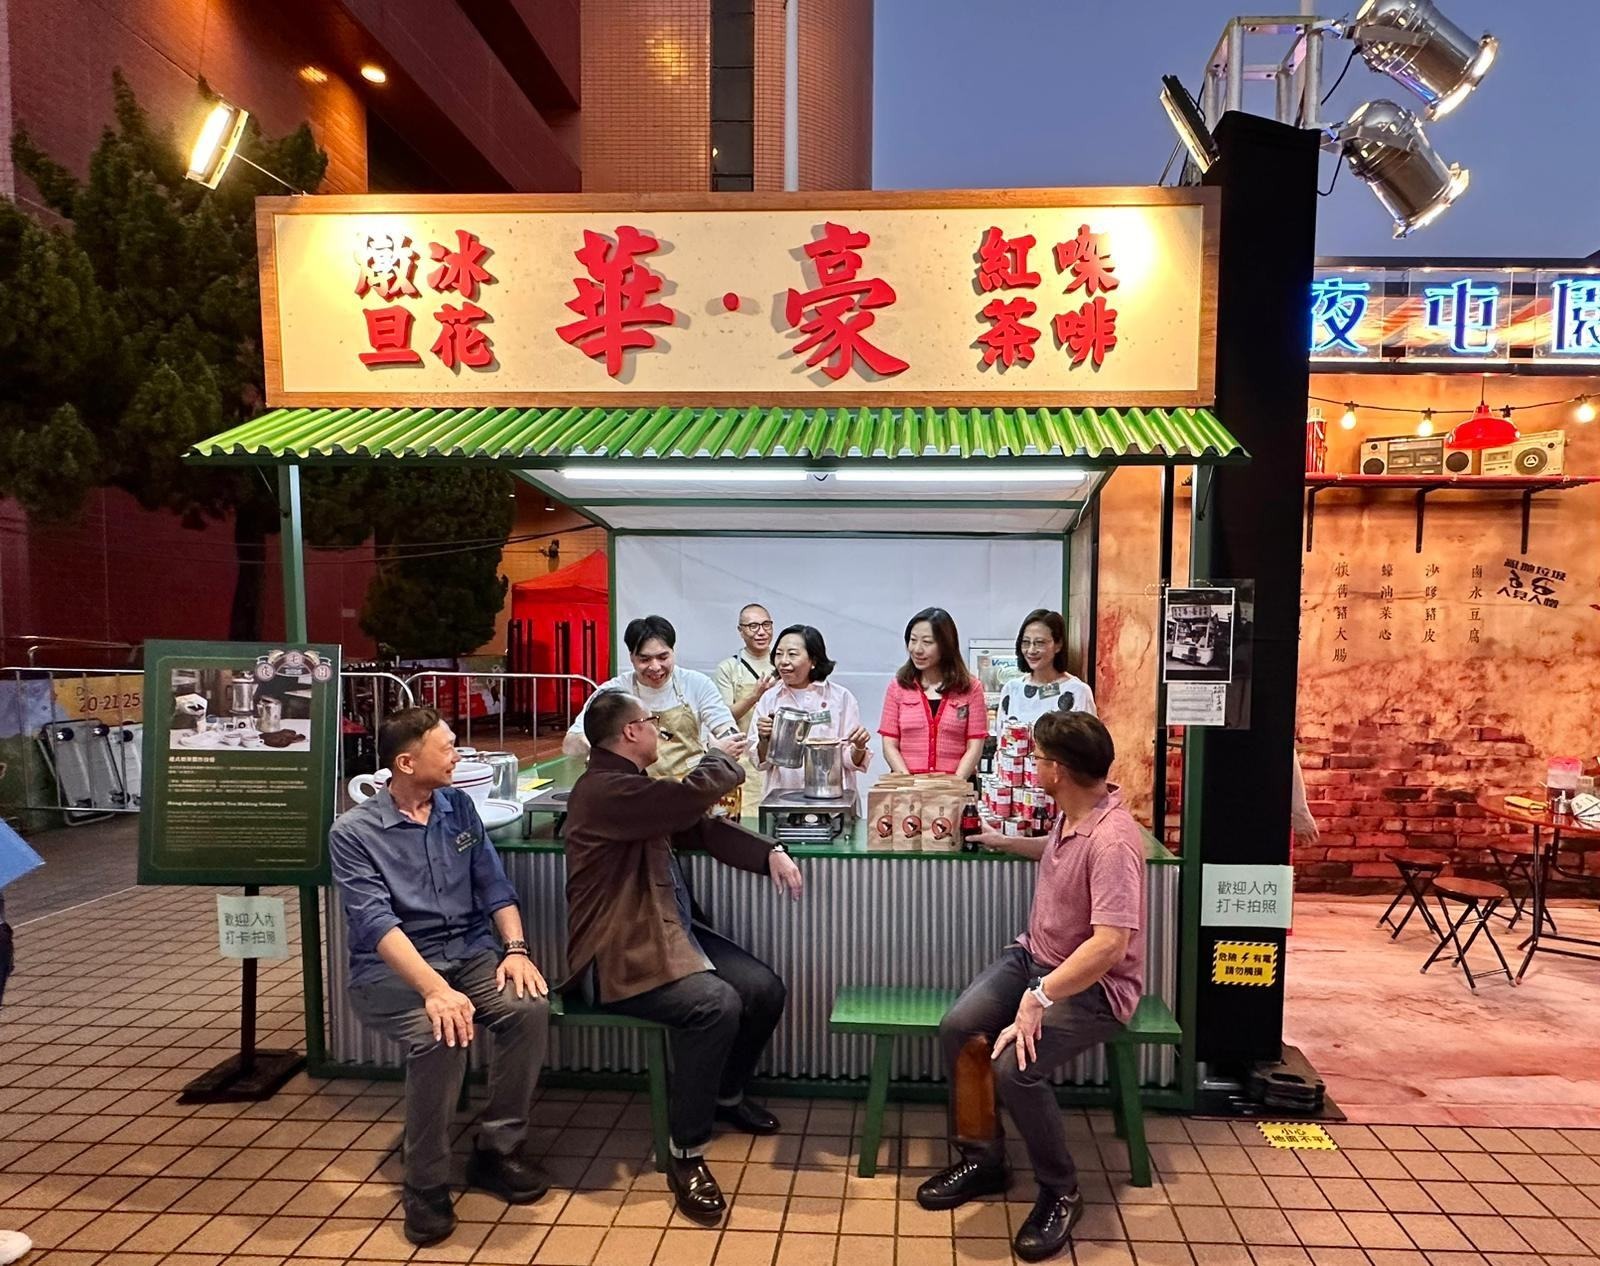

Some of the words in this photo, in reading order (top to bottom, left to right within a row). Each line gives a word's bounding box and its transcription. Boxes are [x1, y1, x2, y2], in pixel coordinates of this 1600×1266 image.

[427, 229, 494, 368] 冰花
[977, 226, 1042, 368] 紅茶
[1216, 899, 1277, 914] 打卡拍照
